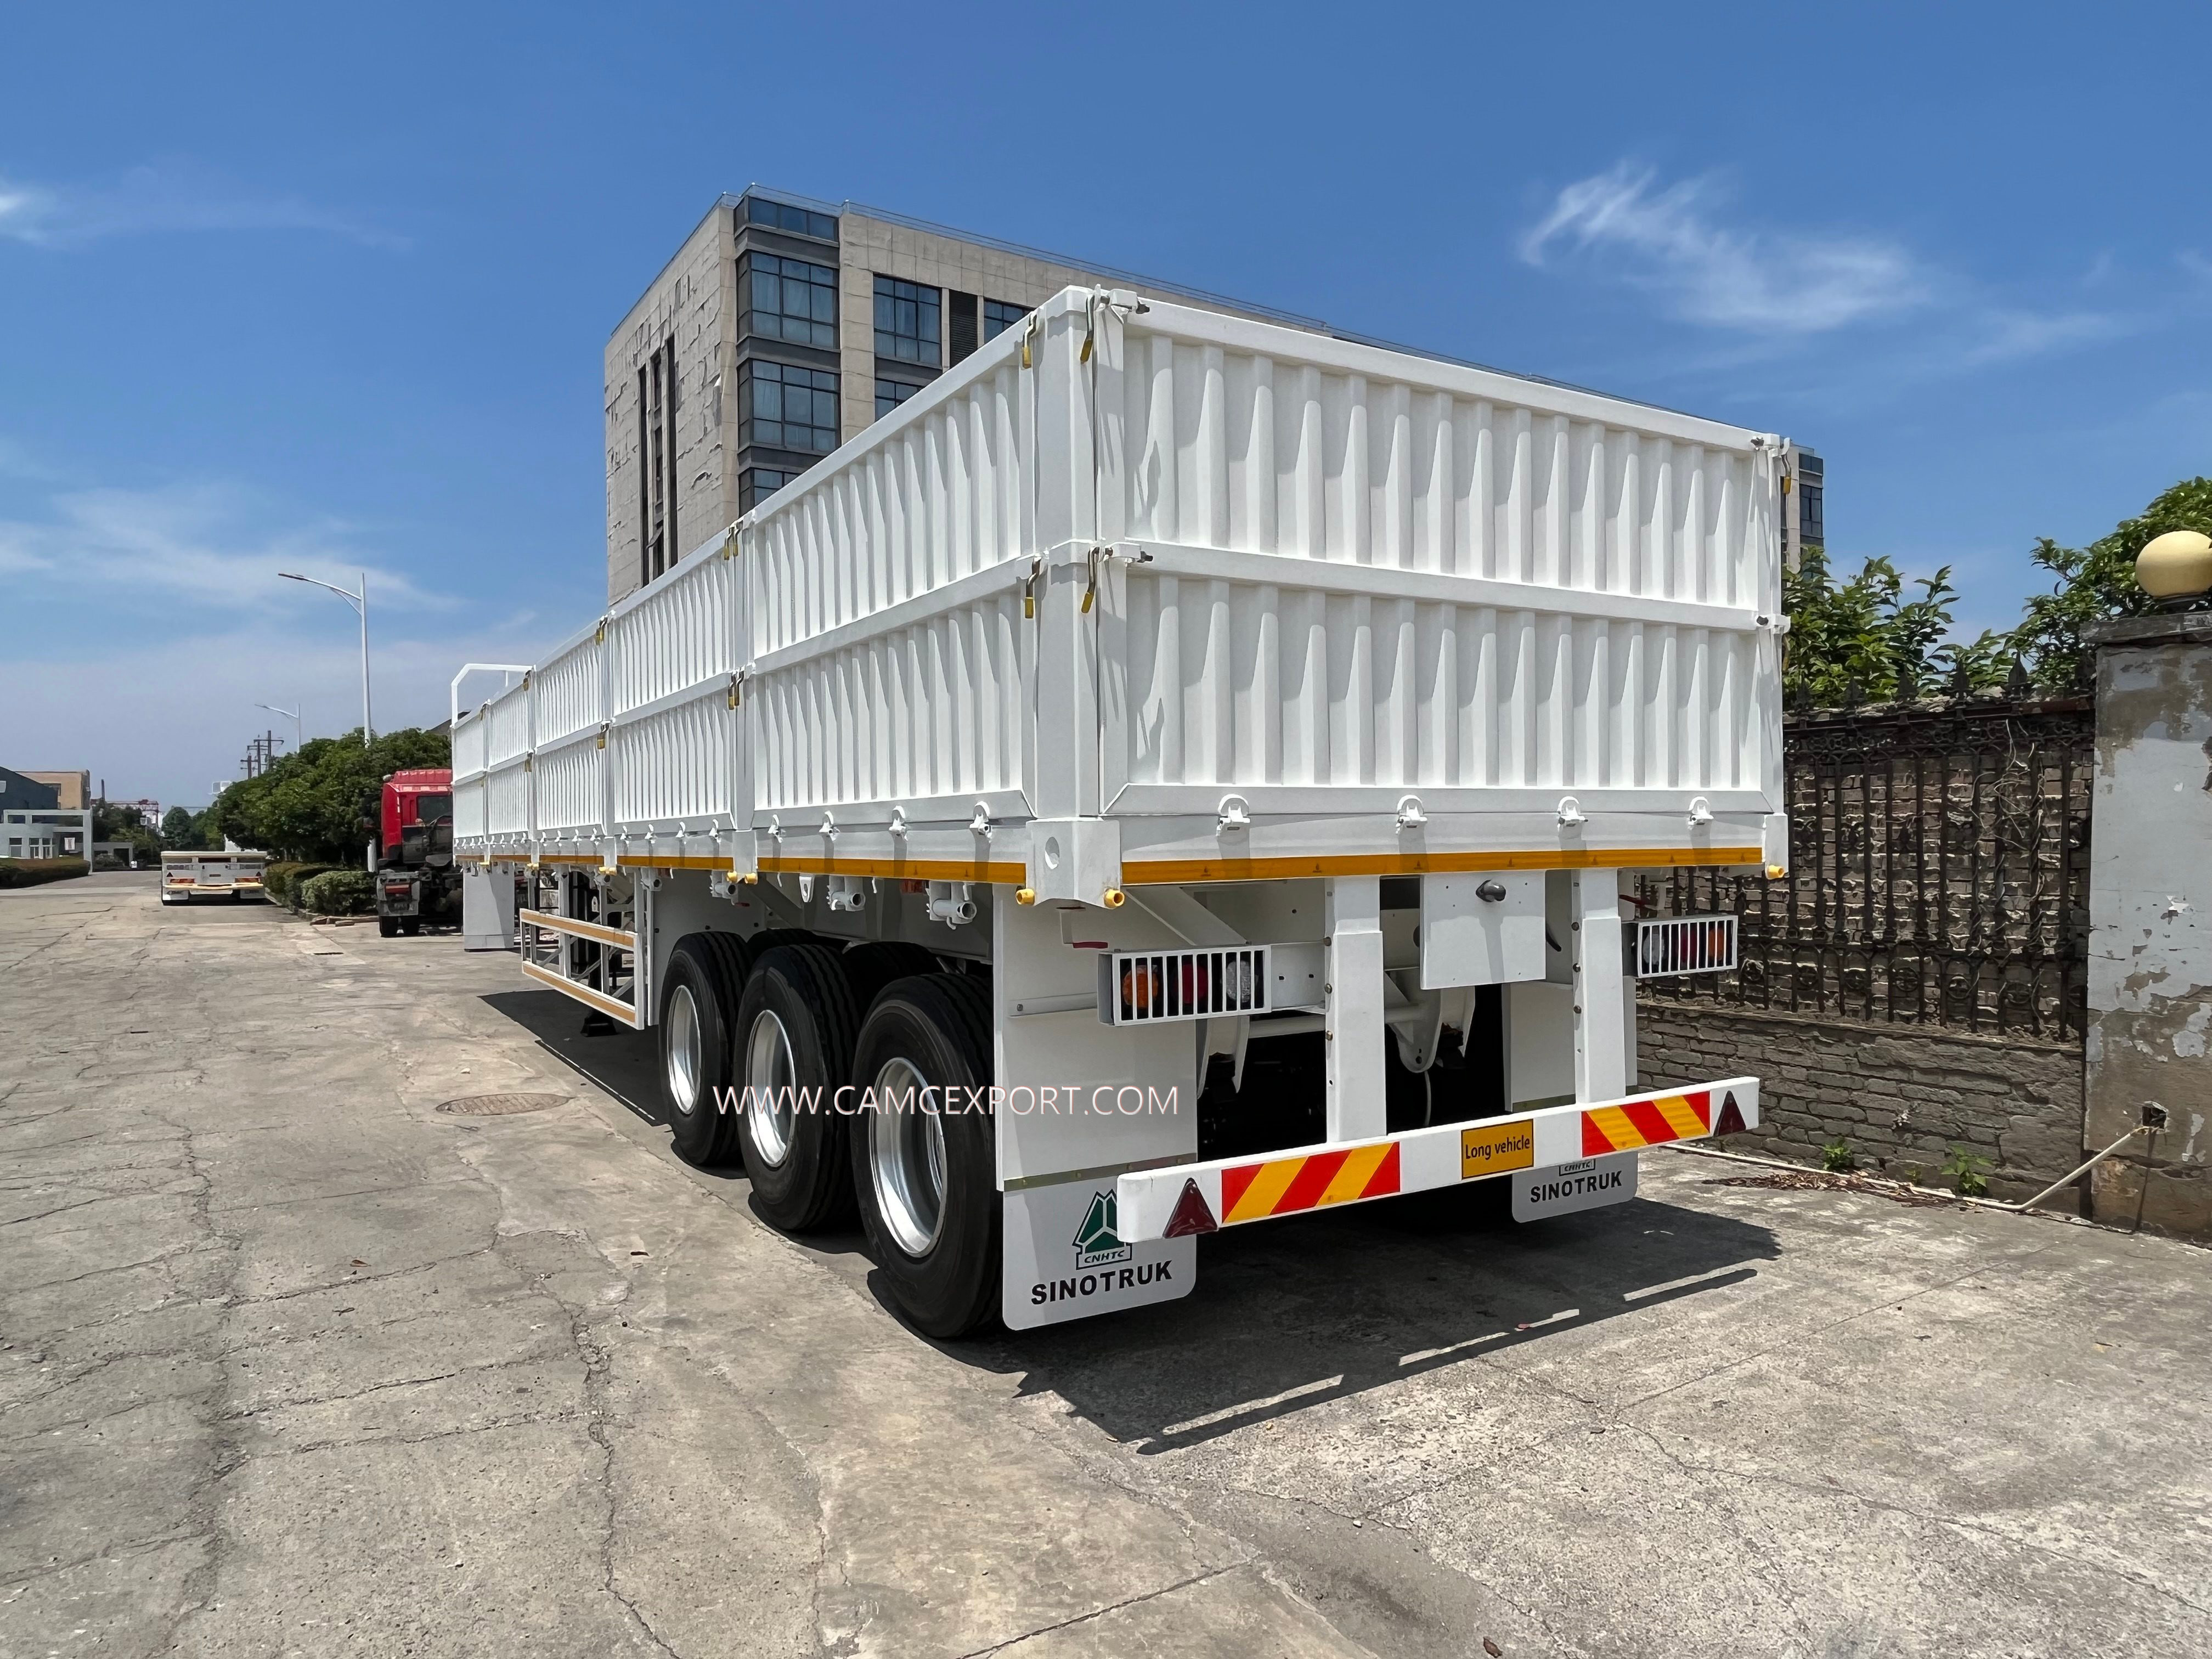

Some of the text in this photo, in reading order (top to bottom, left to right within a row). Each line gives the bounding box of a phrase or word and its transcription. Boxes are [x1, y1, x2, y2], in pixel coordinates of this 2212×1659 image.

[1465, 1135, 1530, 1160] Long vehicle
[1530, 1171, 1622, 1203] SINOTRUK
[1084, 1250, 1125, 1263] CNHTC
[1031, 1260, 1172, 1305] SINOTRUK
